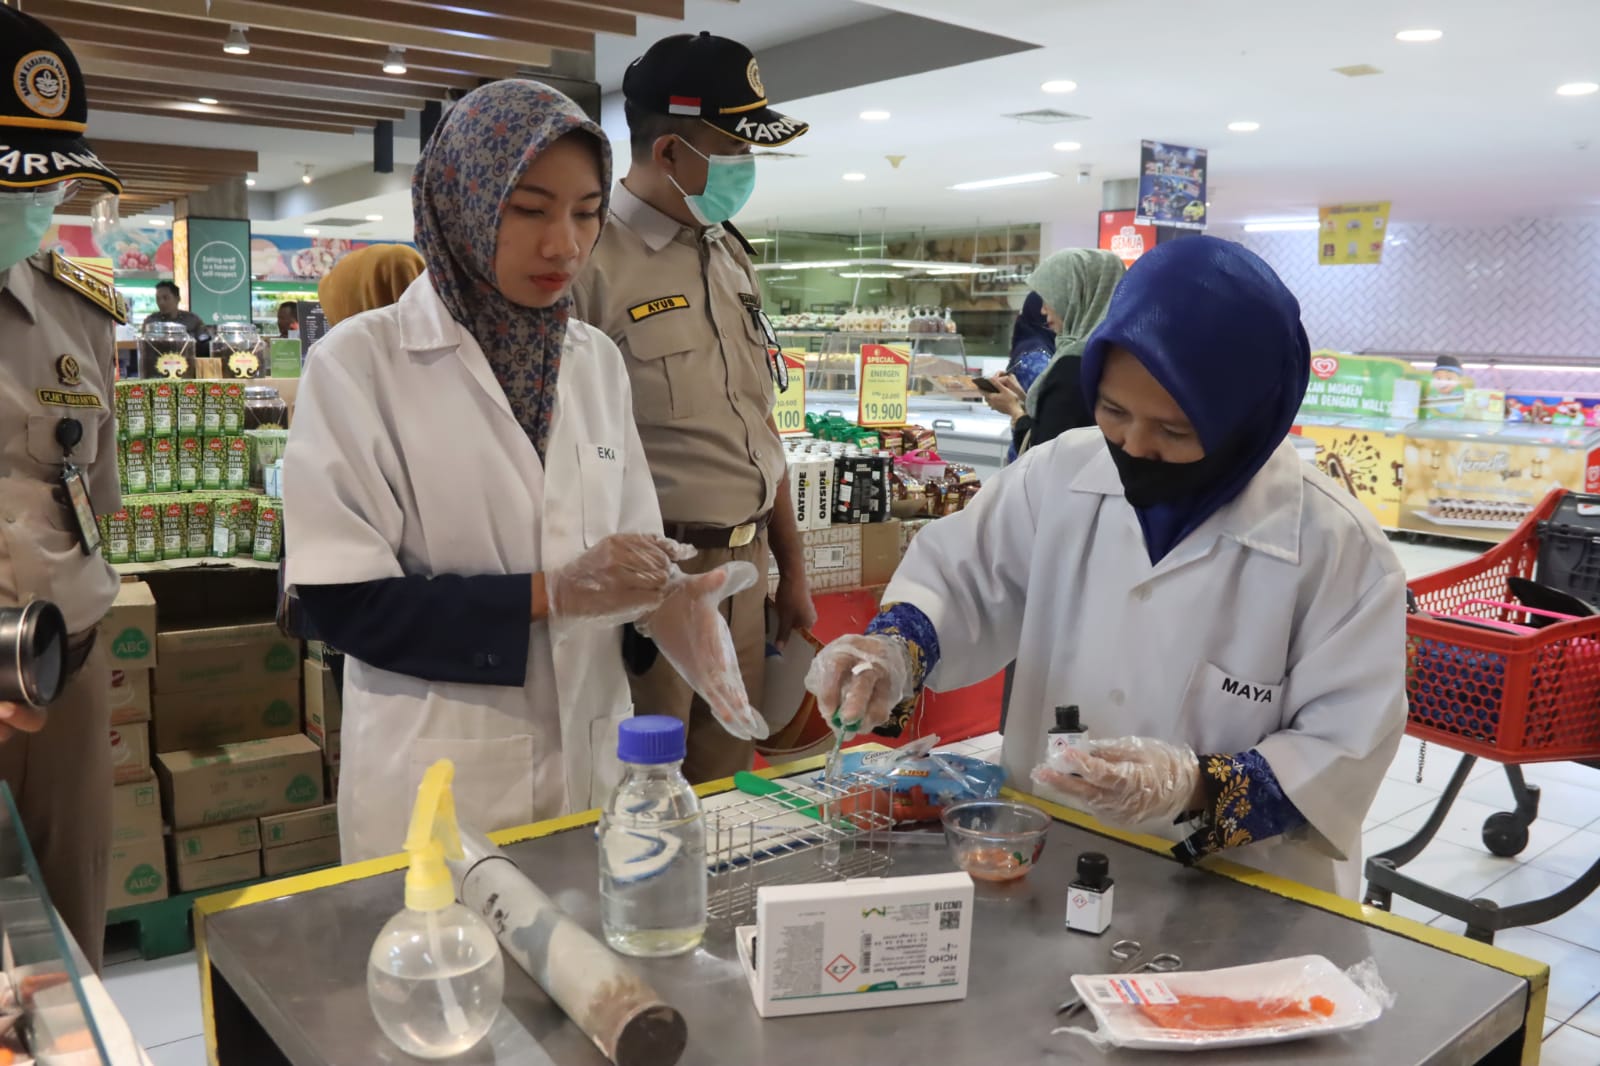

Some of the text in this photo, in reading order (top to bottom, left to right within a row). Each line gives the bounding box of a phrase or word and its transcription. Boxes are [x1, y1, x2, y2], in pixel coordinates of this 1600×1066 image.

[647, 298, 675, 312] AYUB
[865, 403, 902, 420] 19.900
[797, 471, 807, 522] OATSIDE
[803, 526, 861, 545] OATSIDE
[116, 640, 147, 654] ABC
[1222, 677, 1272, 703] MAYA
[128, 874, 158, 888] ABC
[928, 954, 958, 964] HCHO
